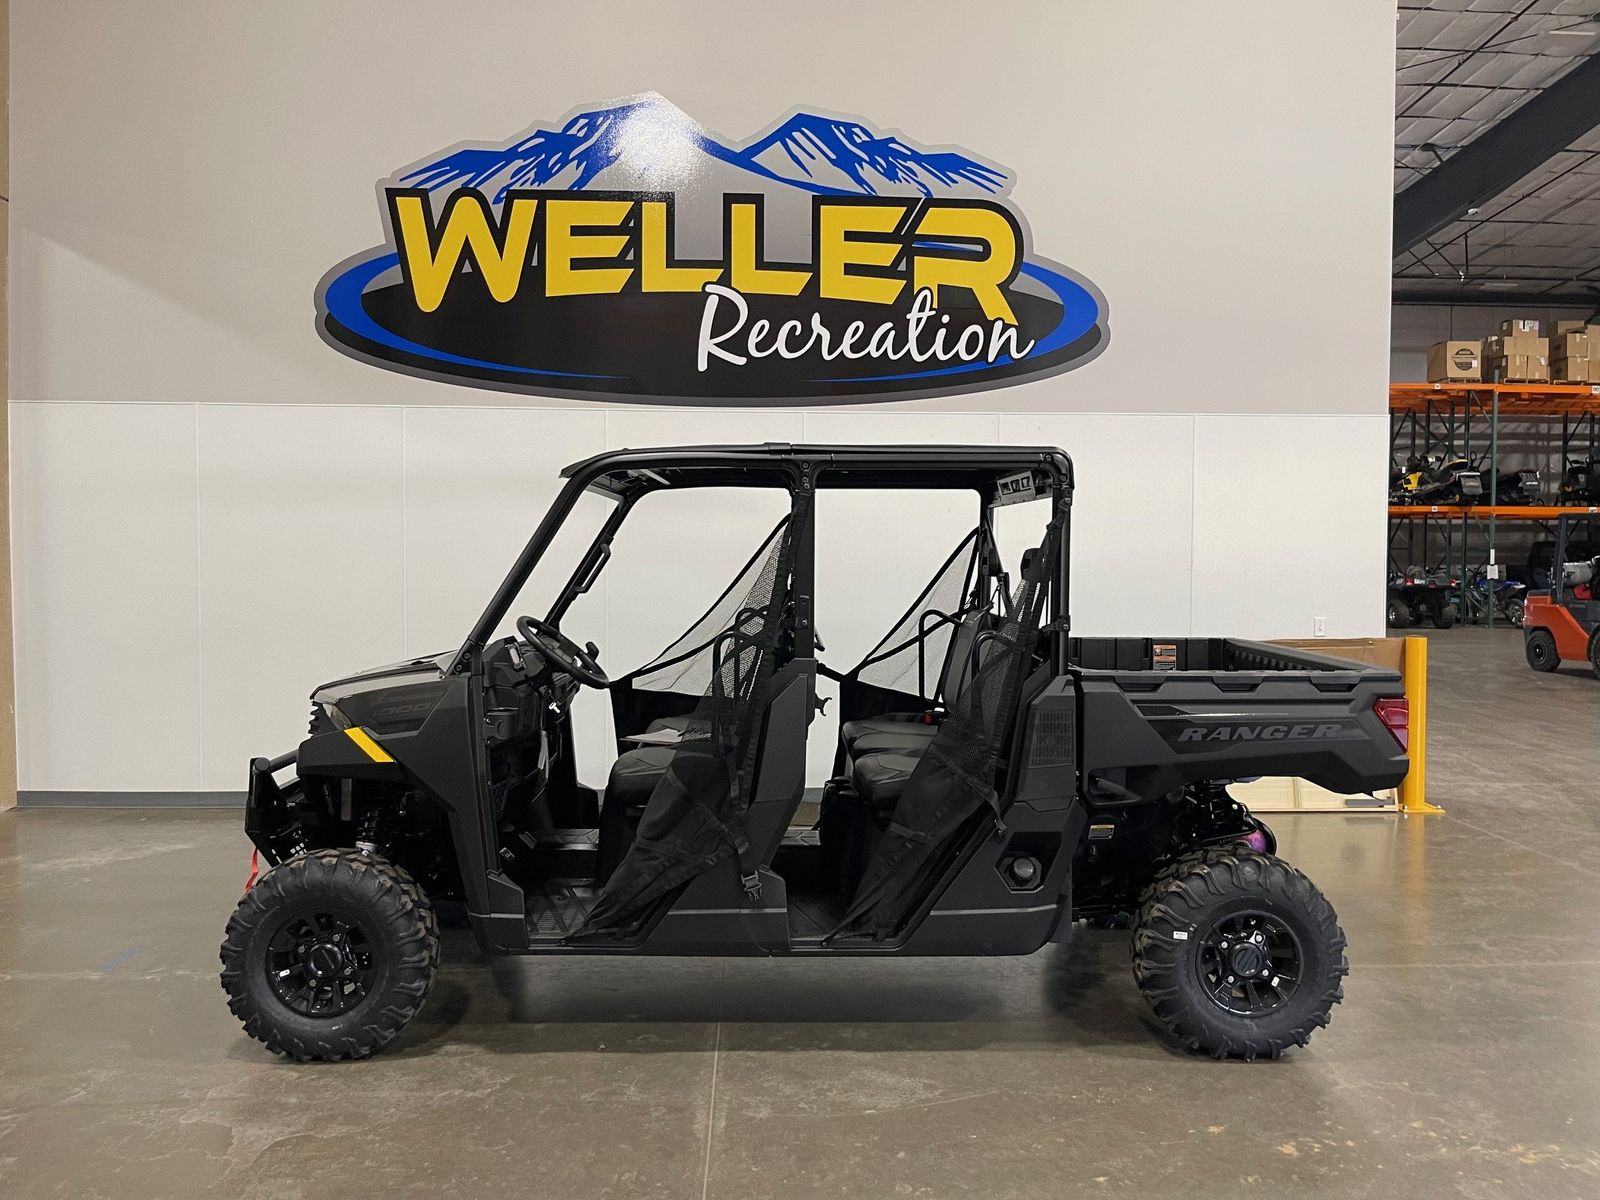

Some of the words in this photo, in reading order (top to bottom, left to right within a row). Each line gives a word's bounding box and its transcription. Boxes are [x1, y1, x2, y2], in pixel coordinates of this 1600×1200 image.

[396, 196, 1018, 325] WELLER
[697, 284, 1036, 373] Recreation
[1177, 724, 1342, 741] RANGER
